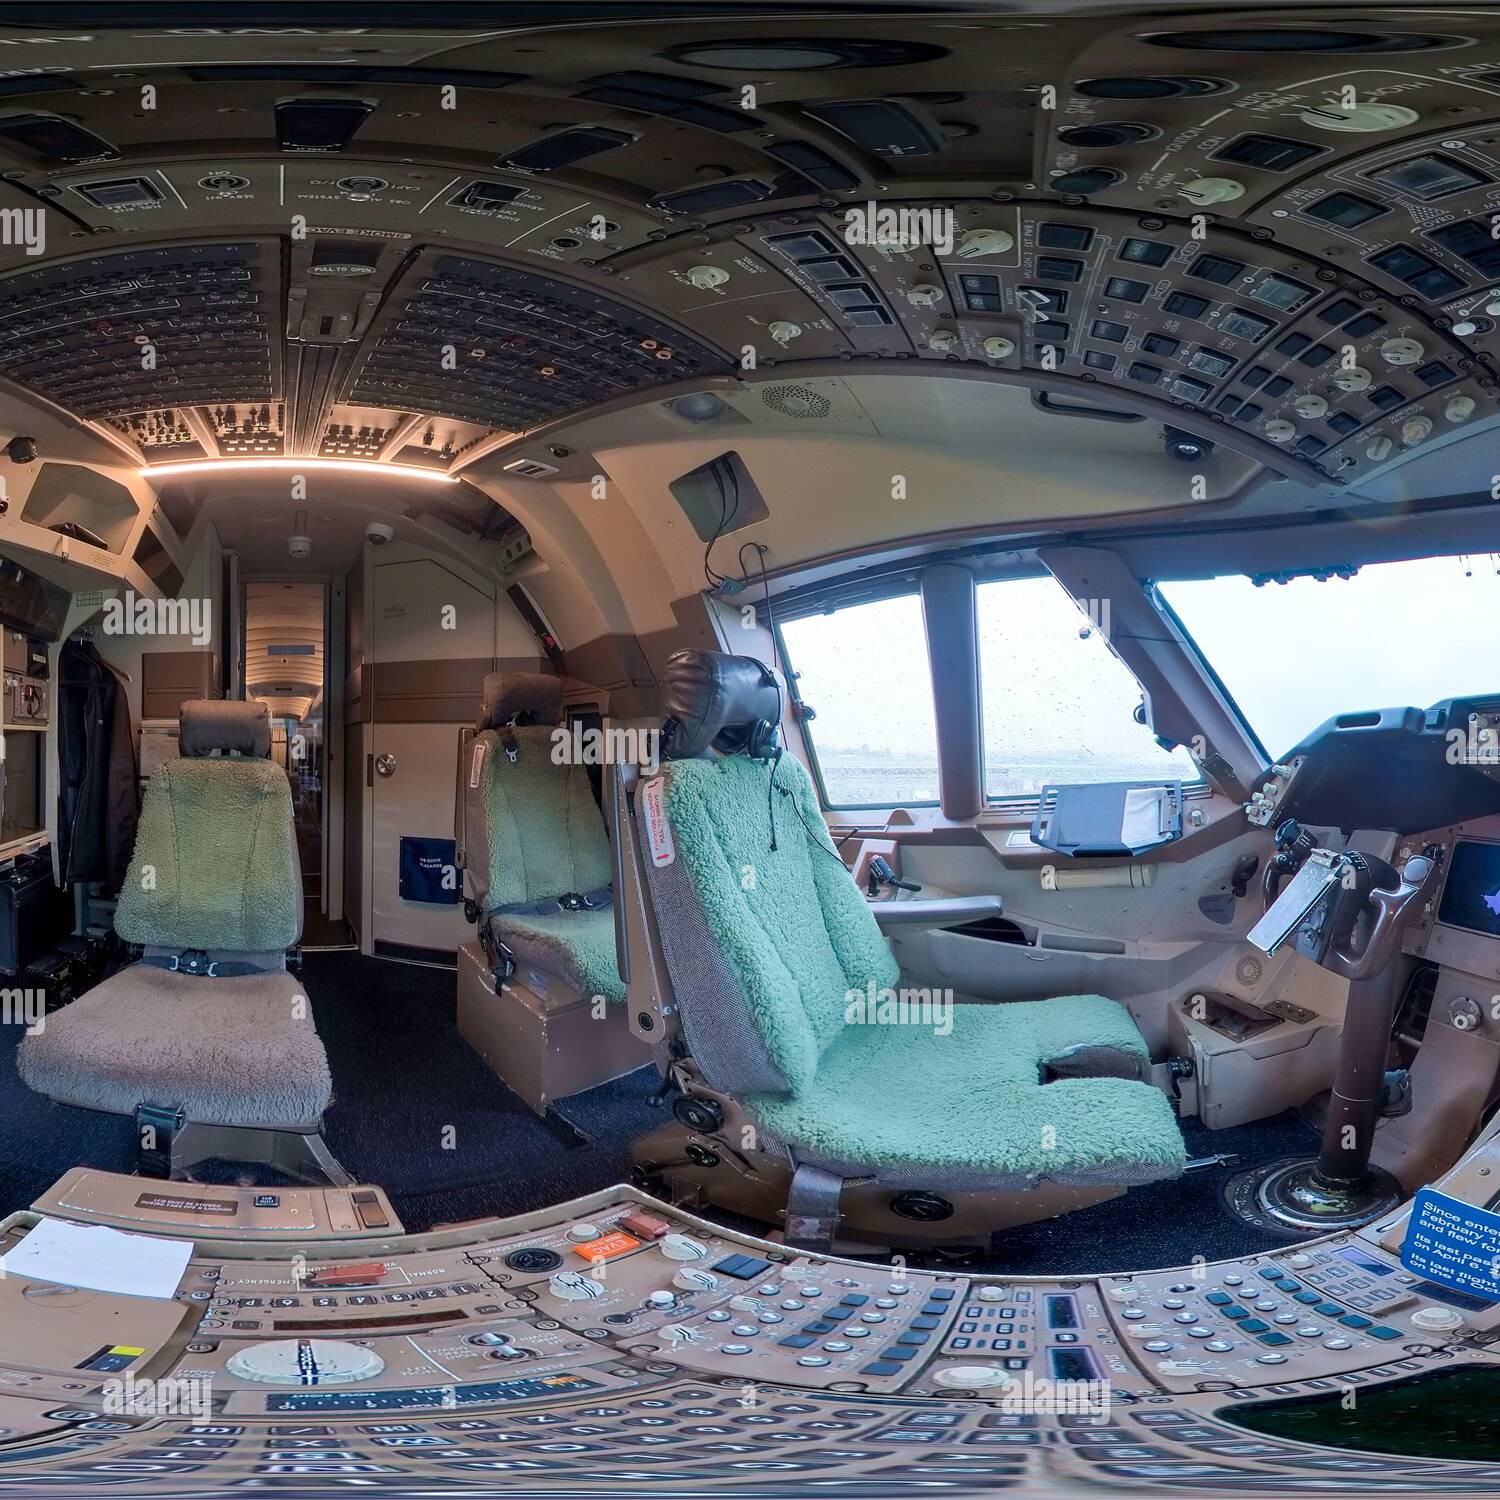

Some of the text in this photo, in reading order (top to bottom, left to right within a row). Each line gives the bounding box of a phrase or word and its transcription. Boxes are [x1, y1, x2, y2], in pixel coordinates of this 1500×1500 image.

[1365, 81, 1434, 97] BOTH
[1231, 91, 1279, 109] AUTO
[1423, 214, 1456, 229] OVRD
[1359, 243, 1385, 257] MAIN
[1423, 1201, 1461, 1223] Since
[1419, 1219, 1444, 1233] and
[1448, 1230, 1478, 1246] flew
[1421, 1210, 1485, 1240] February
[592, 1239, 627, 1254] EVAC
[1414, 1240, 1430, 1251] on
[1432, 1248, 1465, 1266] April
[1416, 1233, 1431, 1244] Its
[1434, 1240, 1460, 1256] last
[406, 1268, 445, 1279] NORMAL
[1409, 1259, 1426, 1271] on
[1429, 1267, 1452, 1279] the
[1411, 1253, 1427, 1263] Its
[1430, 1260, 1455, 1275] last
[1458, 1271, 1499, 1289] flight
[320, 1298, 329, 1306] 5
